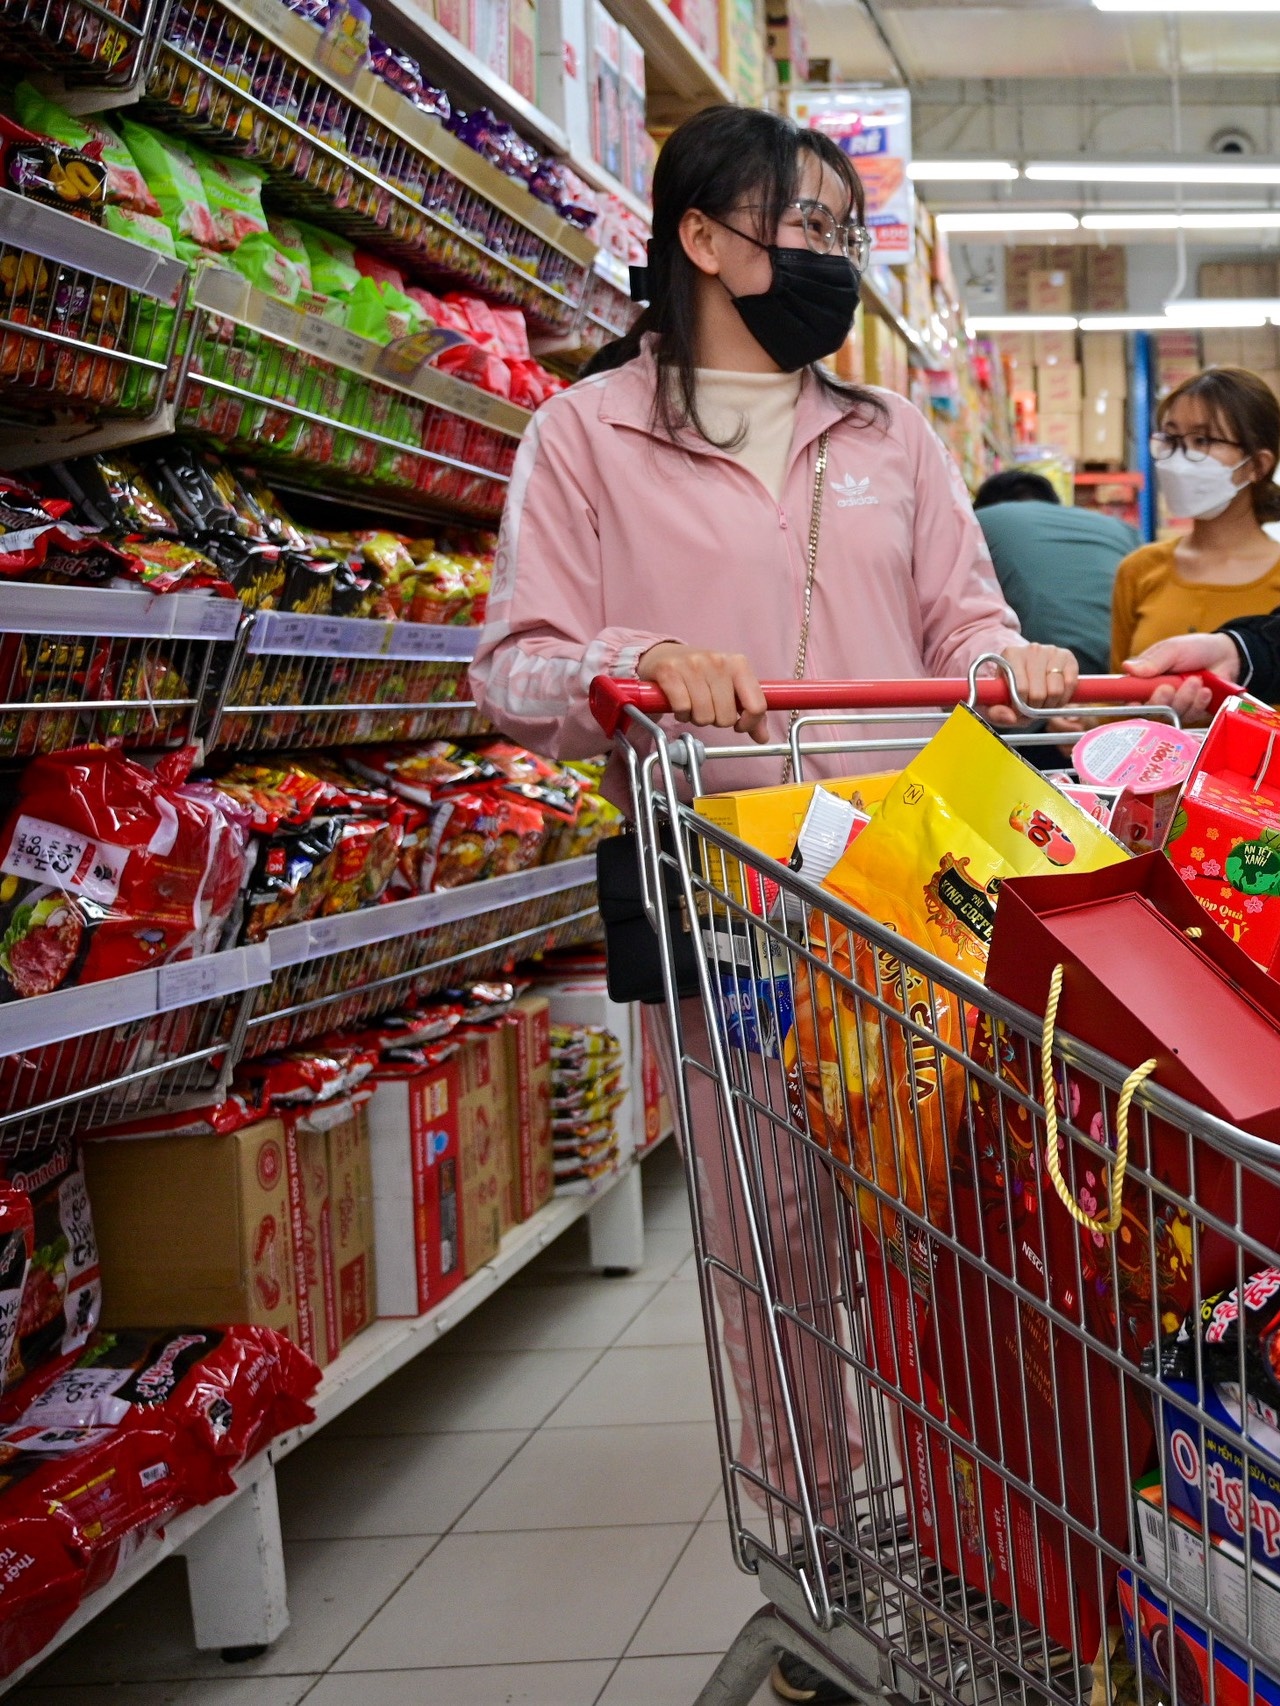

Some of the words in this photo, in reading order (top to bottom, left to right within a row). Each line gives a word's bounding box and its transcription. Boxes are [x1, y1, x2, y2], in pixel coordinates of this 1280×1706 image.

[837, 494, 879, 508] adidas
[1244, 843, 1256, 855] ĂN
[1257, 845, 1274, 859] TẾT
[1244, 854, 1268, 867] XANH
[941, 879, 963, 906] KING
[289, 1172, 300, 1206] 100
[291, 1208, 303, 1250] TRÊN
[914, 1430, 929, 1504] ORION
